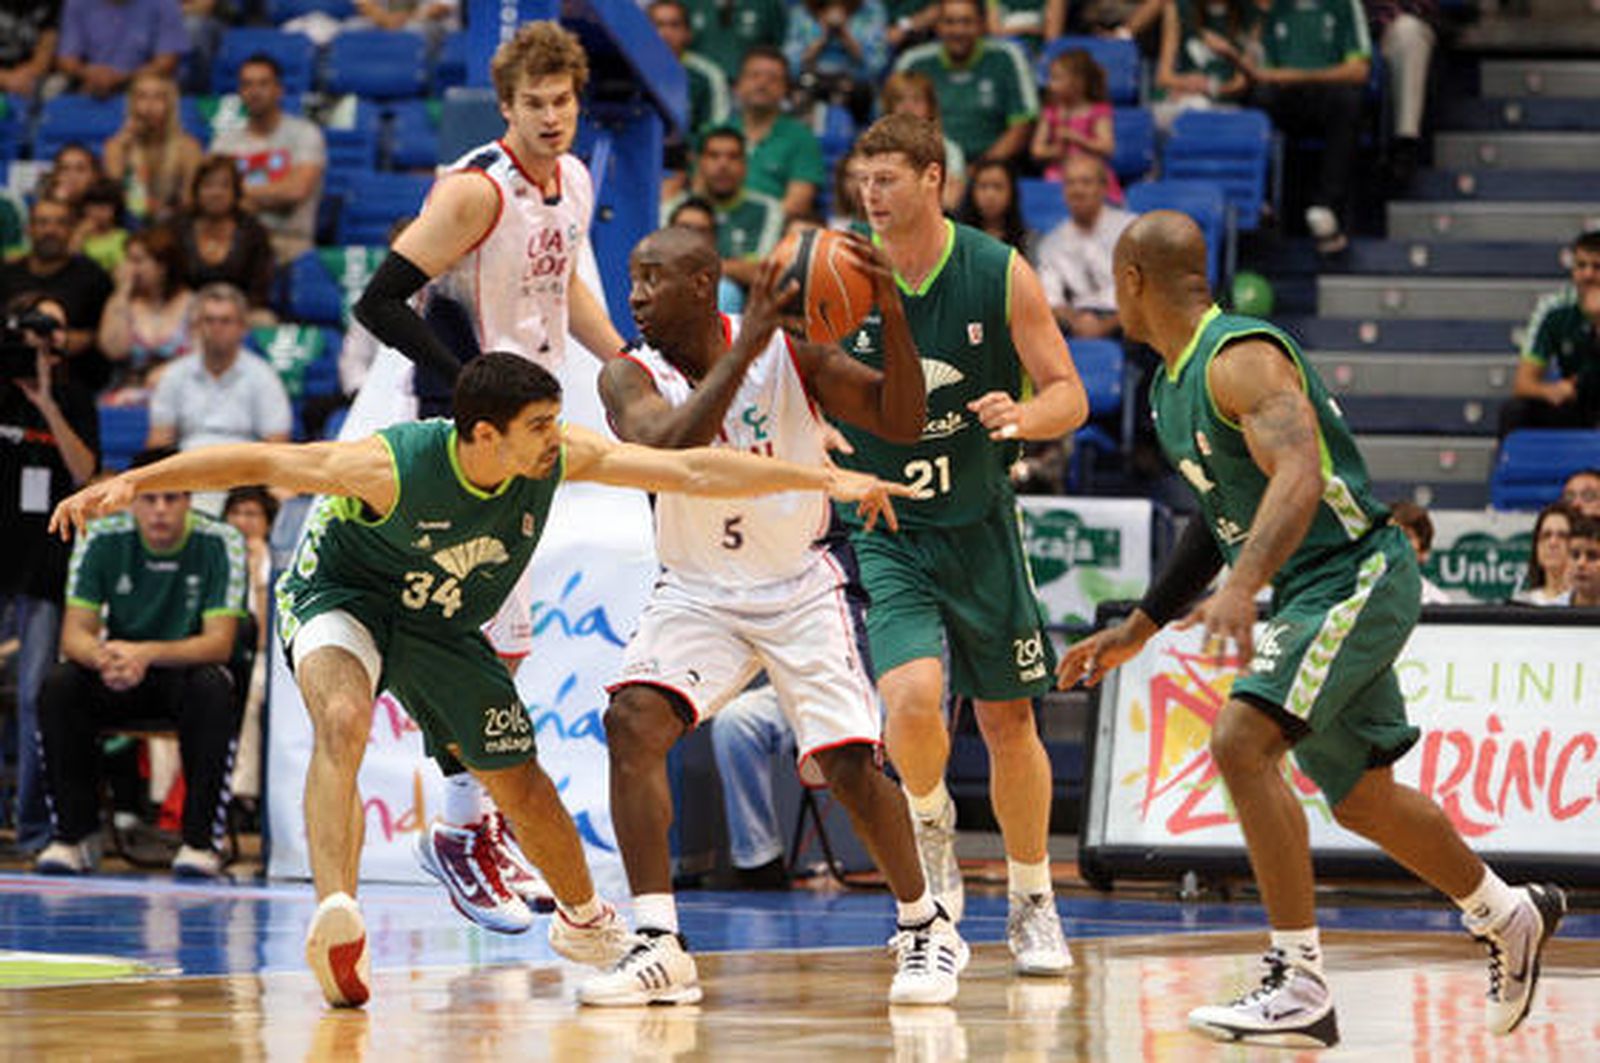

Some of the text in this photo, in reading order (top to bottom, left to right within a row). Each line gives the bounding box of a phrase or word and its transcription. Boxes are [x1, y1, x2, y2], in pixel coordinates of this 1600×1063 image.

[904, 456, 950, 499] 21
[722, 515, 743, 550] 5
[1024, 526, 1096, 567] icaja
[402, 571, 462, 618] 34
[1394, 660, 1584, 703] CLINI
